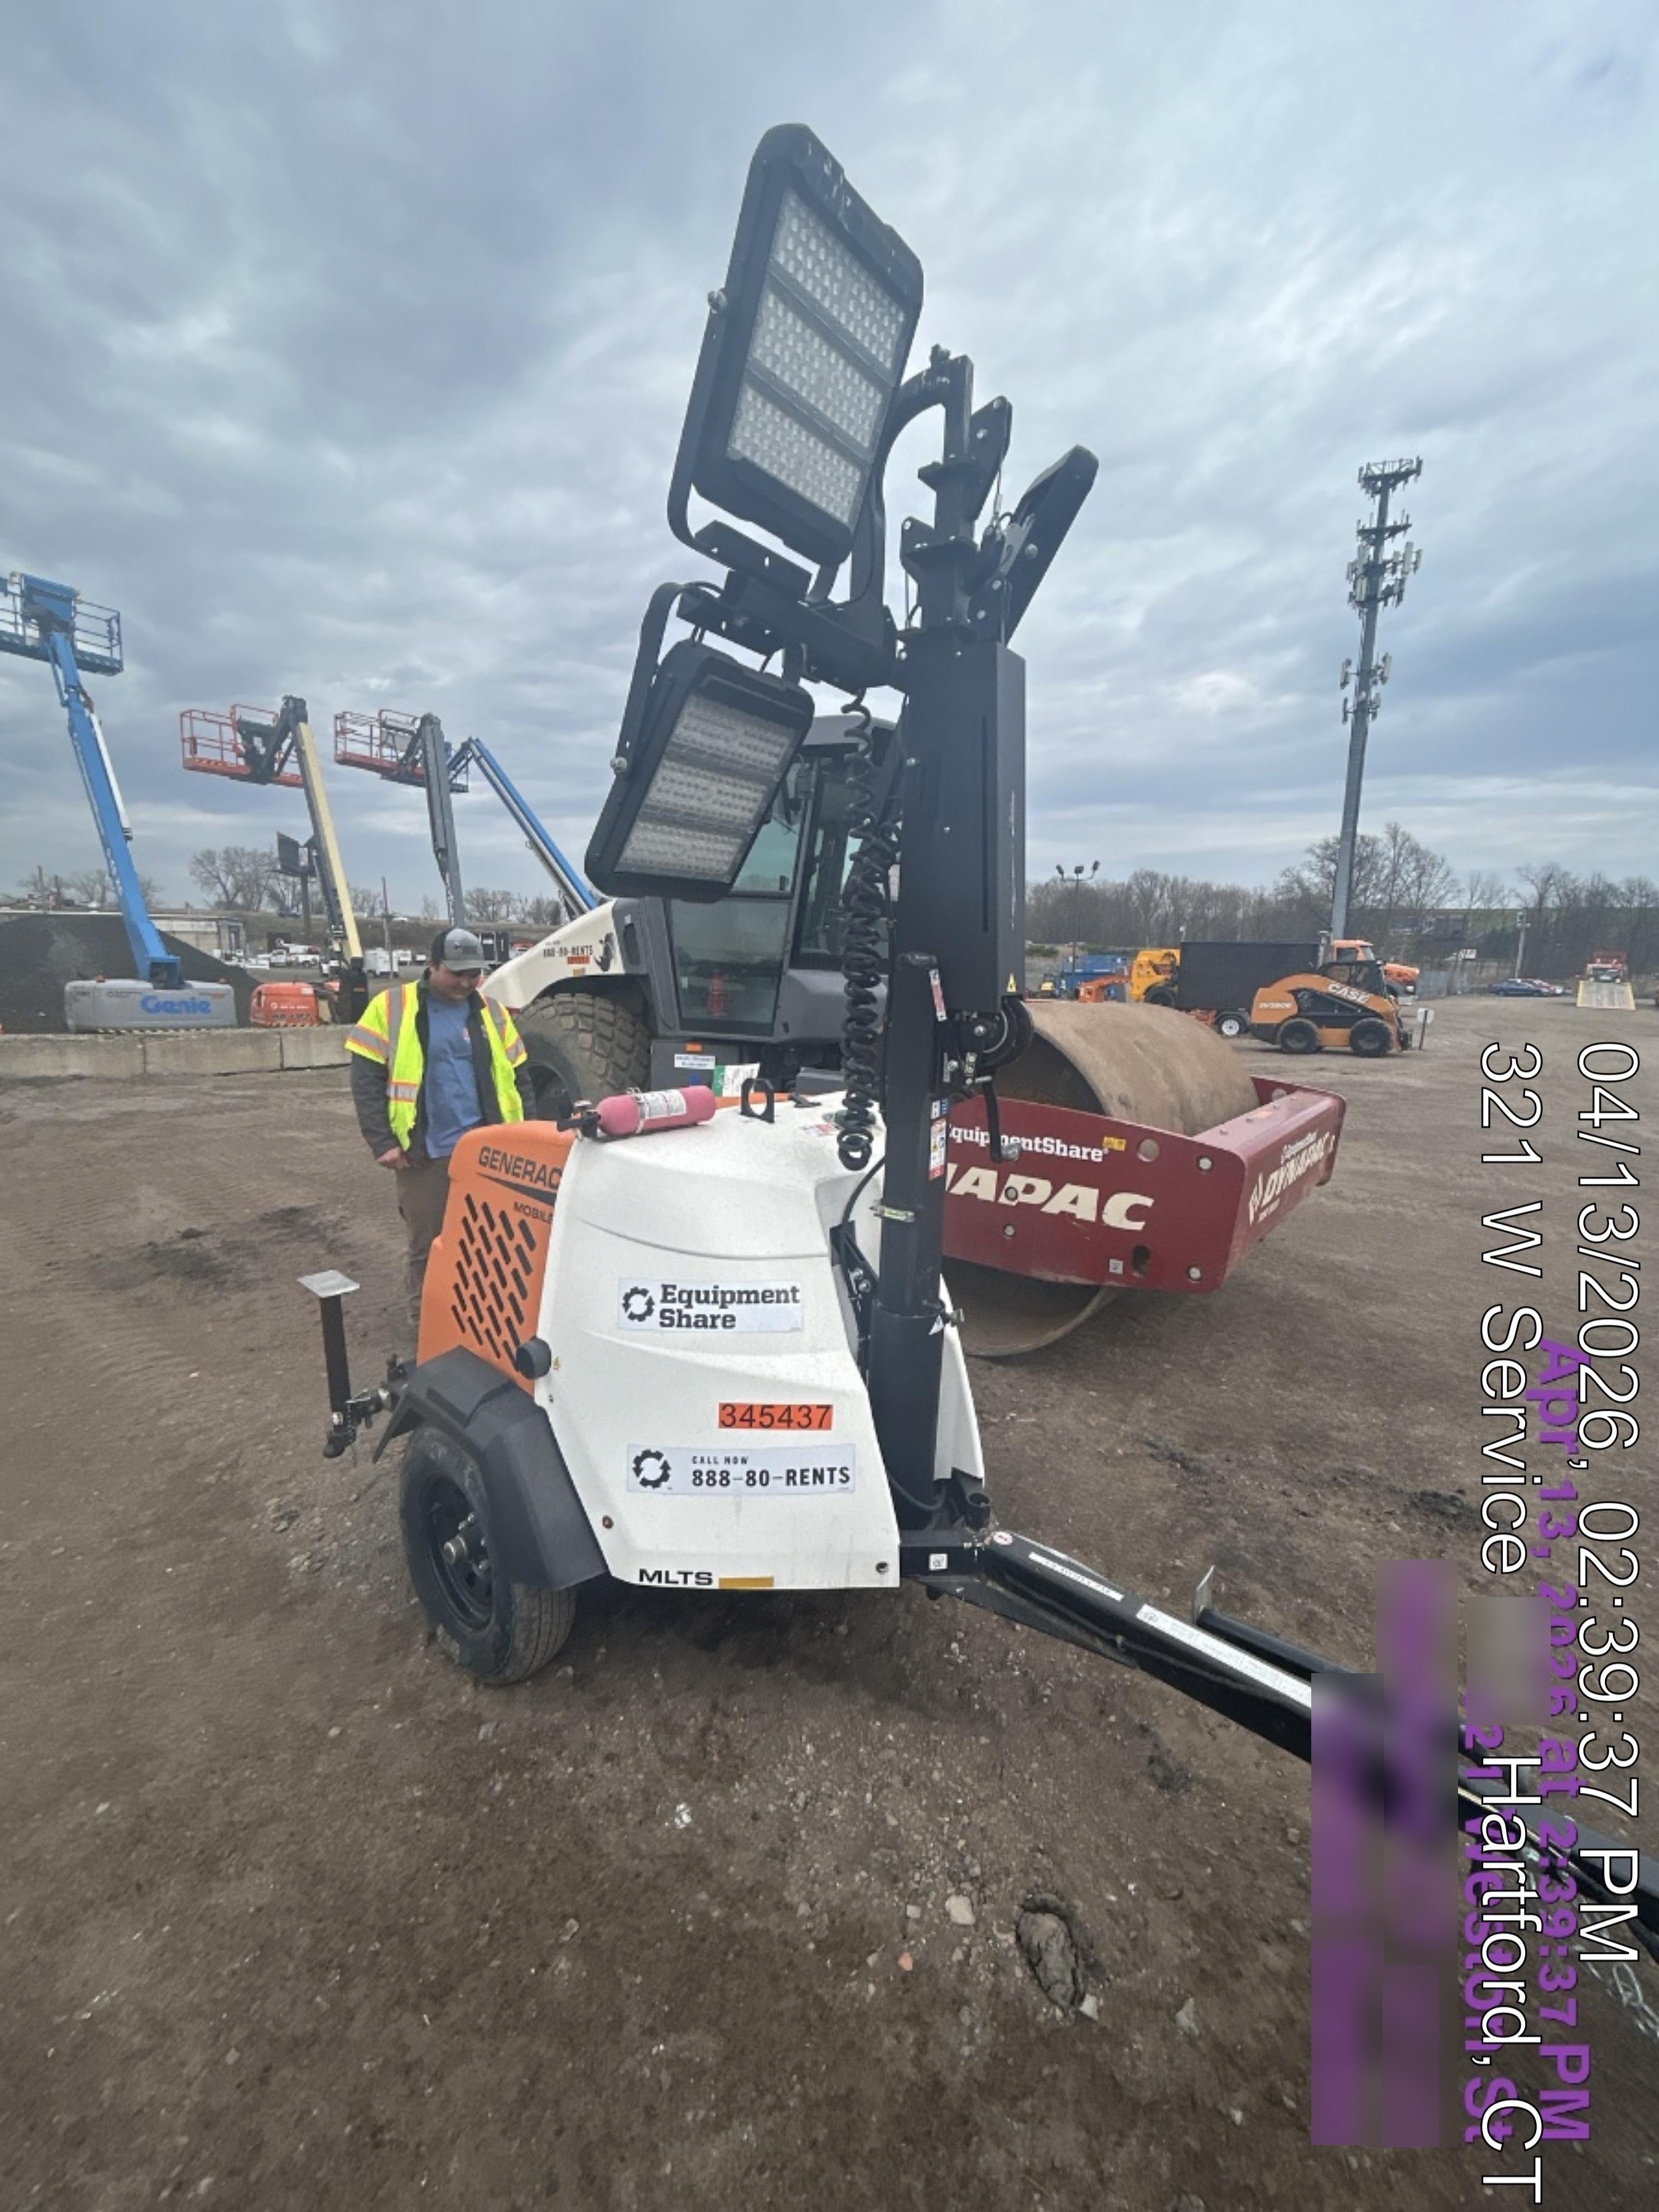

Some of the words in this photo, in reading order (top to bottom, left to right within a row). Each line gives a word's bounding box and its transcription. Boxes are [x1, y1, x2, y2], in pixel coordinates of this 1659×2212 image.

[1328, 979, 1369, 1005] CASE
[141, 994, 211, 1014] Genie
[479, 1146, 563, 1190] GENERAC
[659, 1284, 800, 1309] Equipment
[659, 1308, 736, 1329] Share
[720, 1403, 833, 1429] 345437
[692, 1456, 720, 1465] CALL
[724, 1456, 749, 1465] NOW
[692, 1466, 851, 1488] 888-80-RENTS
[638, 1569, 713, 1586] MLTS
